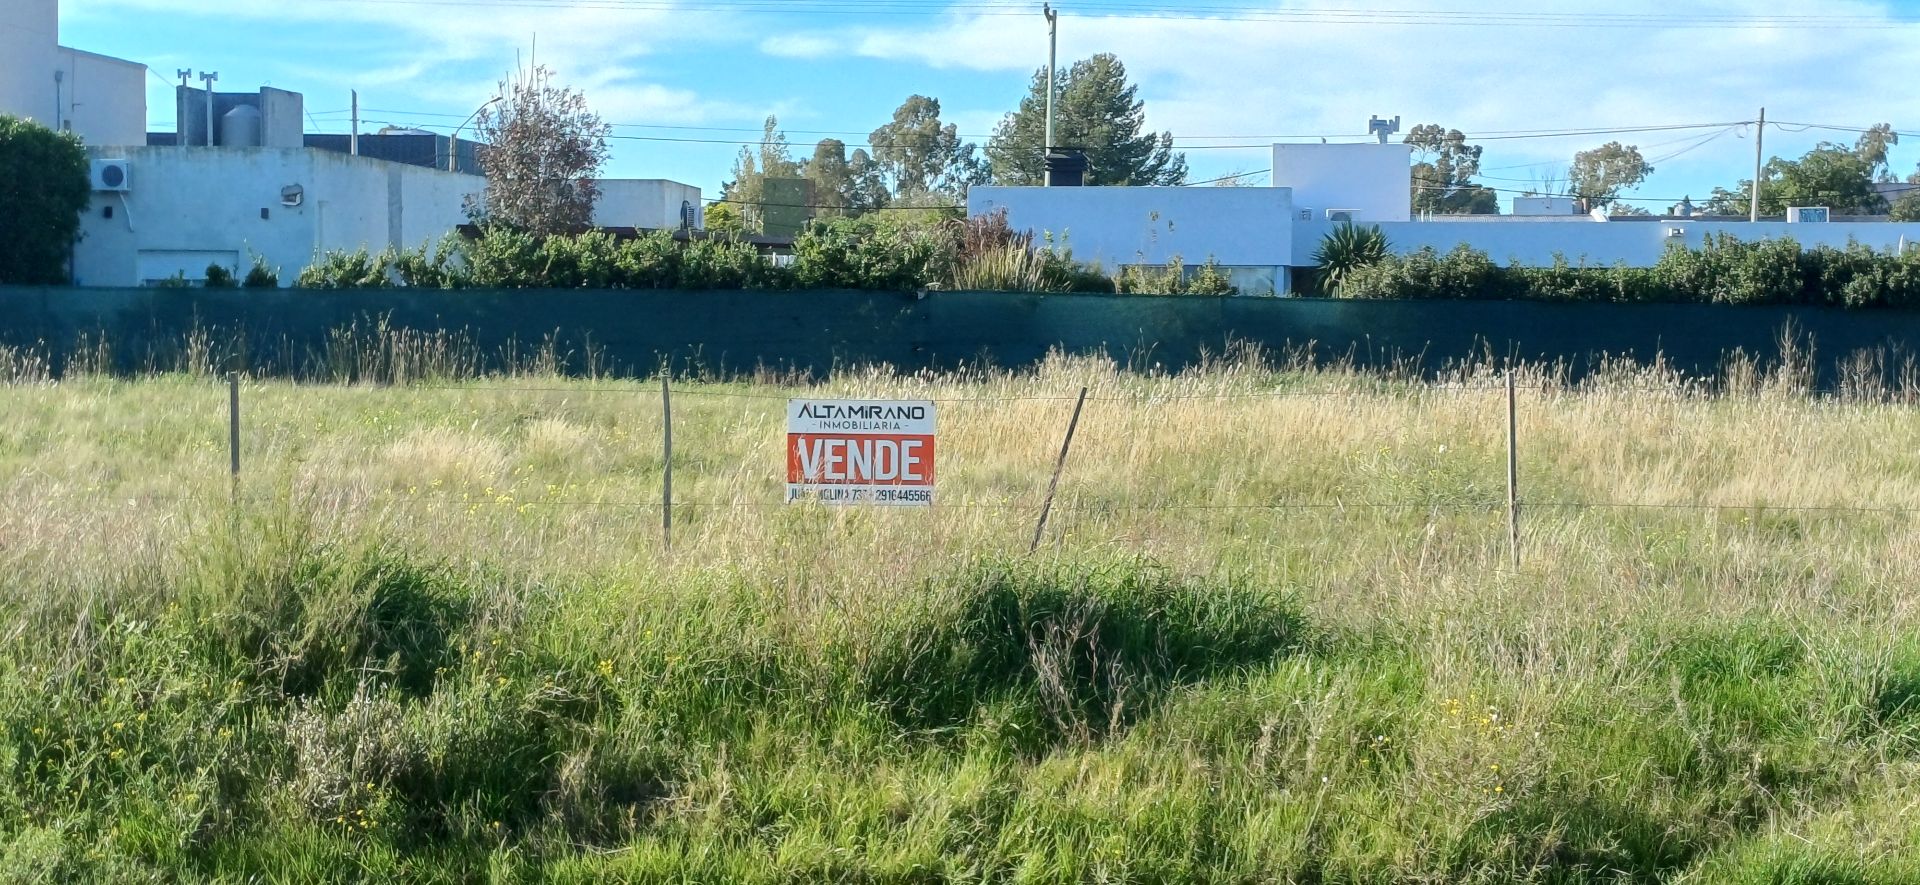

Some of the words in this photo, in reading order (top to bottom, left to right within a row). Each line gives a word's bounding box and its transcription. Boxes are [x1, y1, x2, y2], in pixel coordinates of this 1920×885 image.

[819, 420, 900, 430] INMOBILIARIA
[798, 438, 923, 480] VENDE
[876, 488, 931, 501] 2916445566
